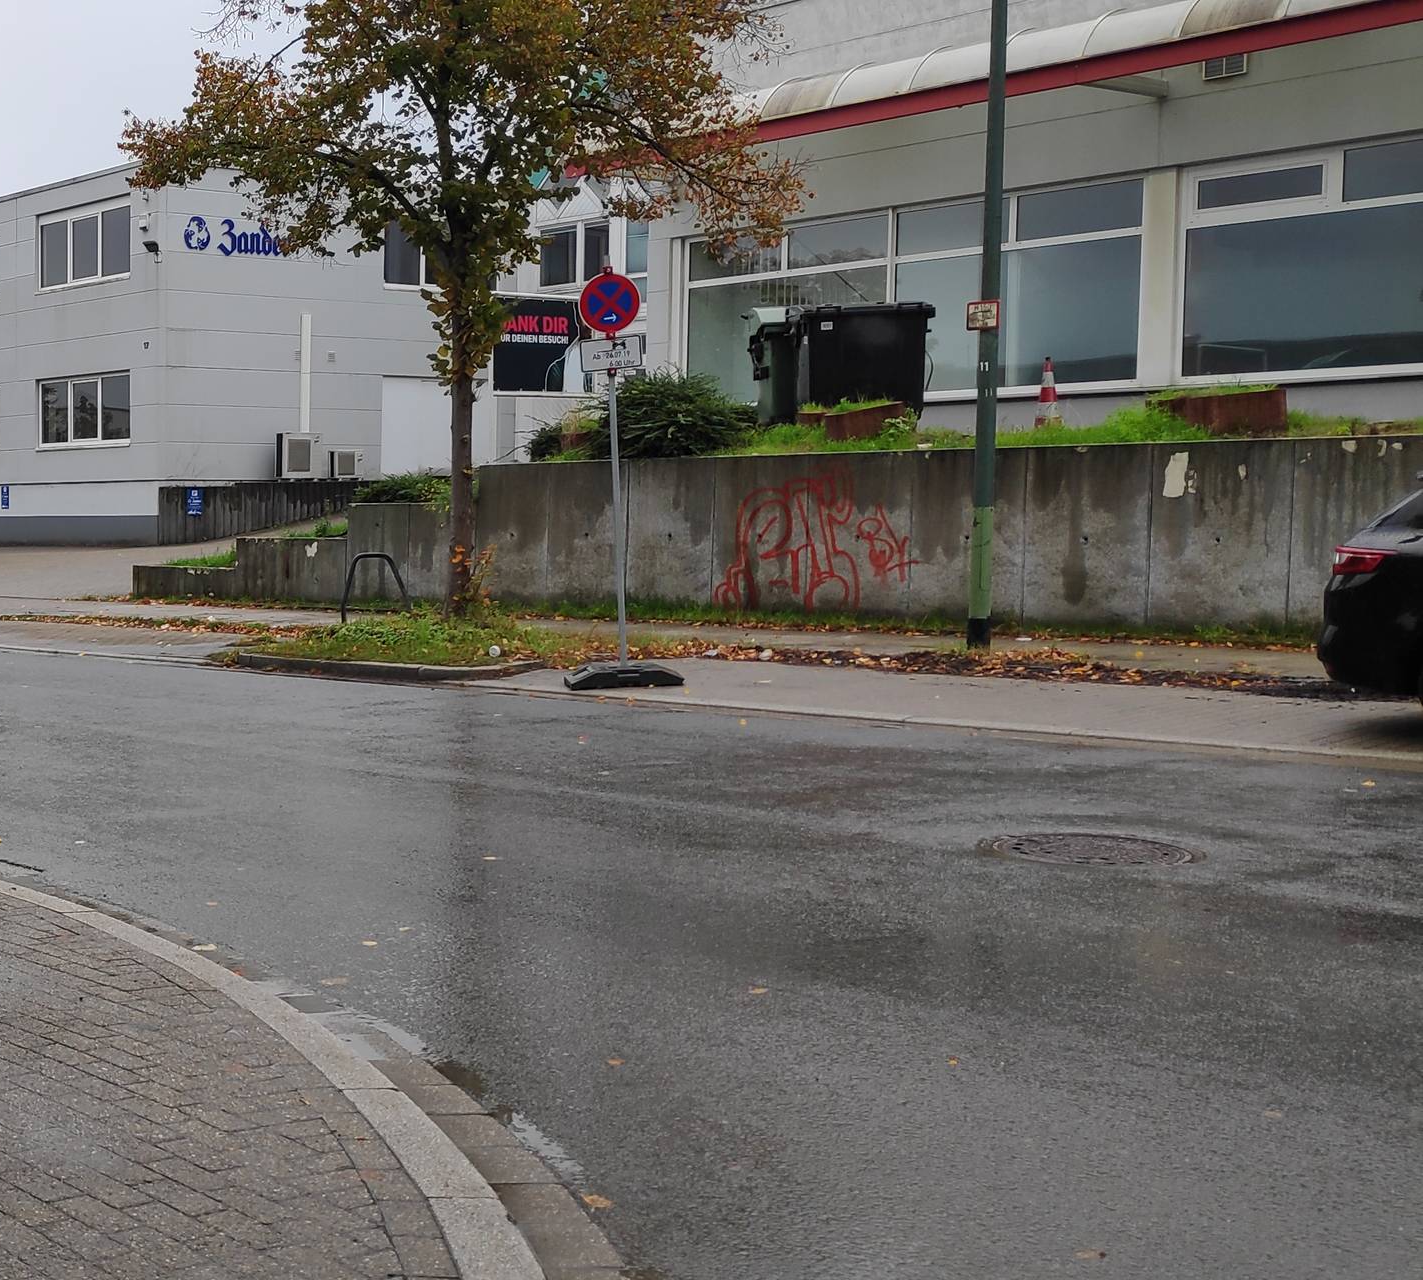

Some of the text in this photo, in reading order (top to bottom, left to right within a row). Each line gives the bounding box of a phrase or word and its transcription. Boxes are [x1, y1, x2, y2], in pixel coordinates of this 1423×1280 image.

[217, 219, 283, 257] Zande
[503, 315, 568, 334] ANK DIR
[512, 334, 537, 343] DEINEN
[539, 336, 568, 345] BESUCH!
[979, 361, 989, 371] 11
